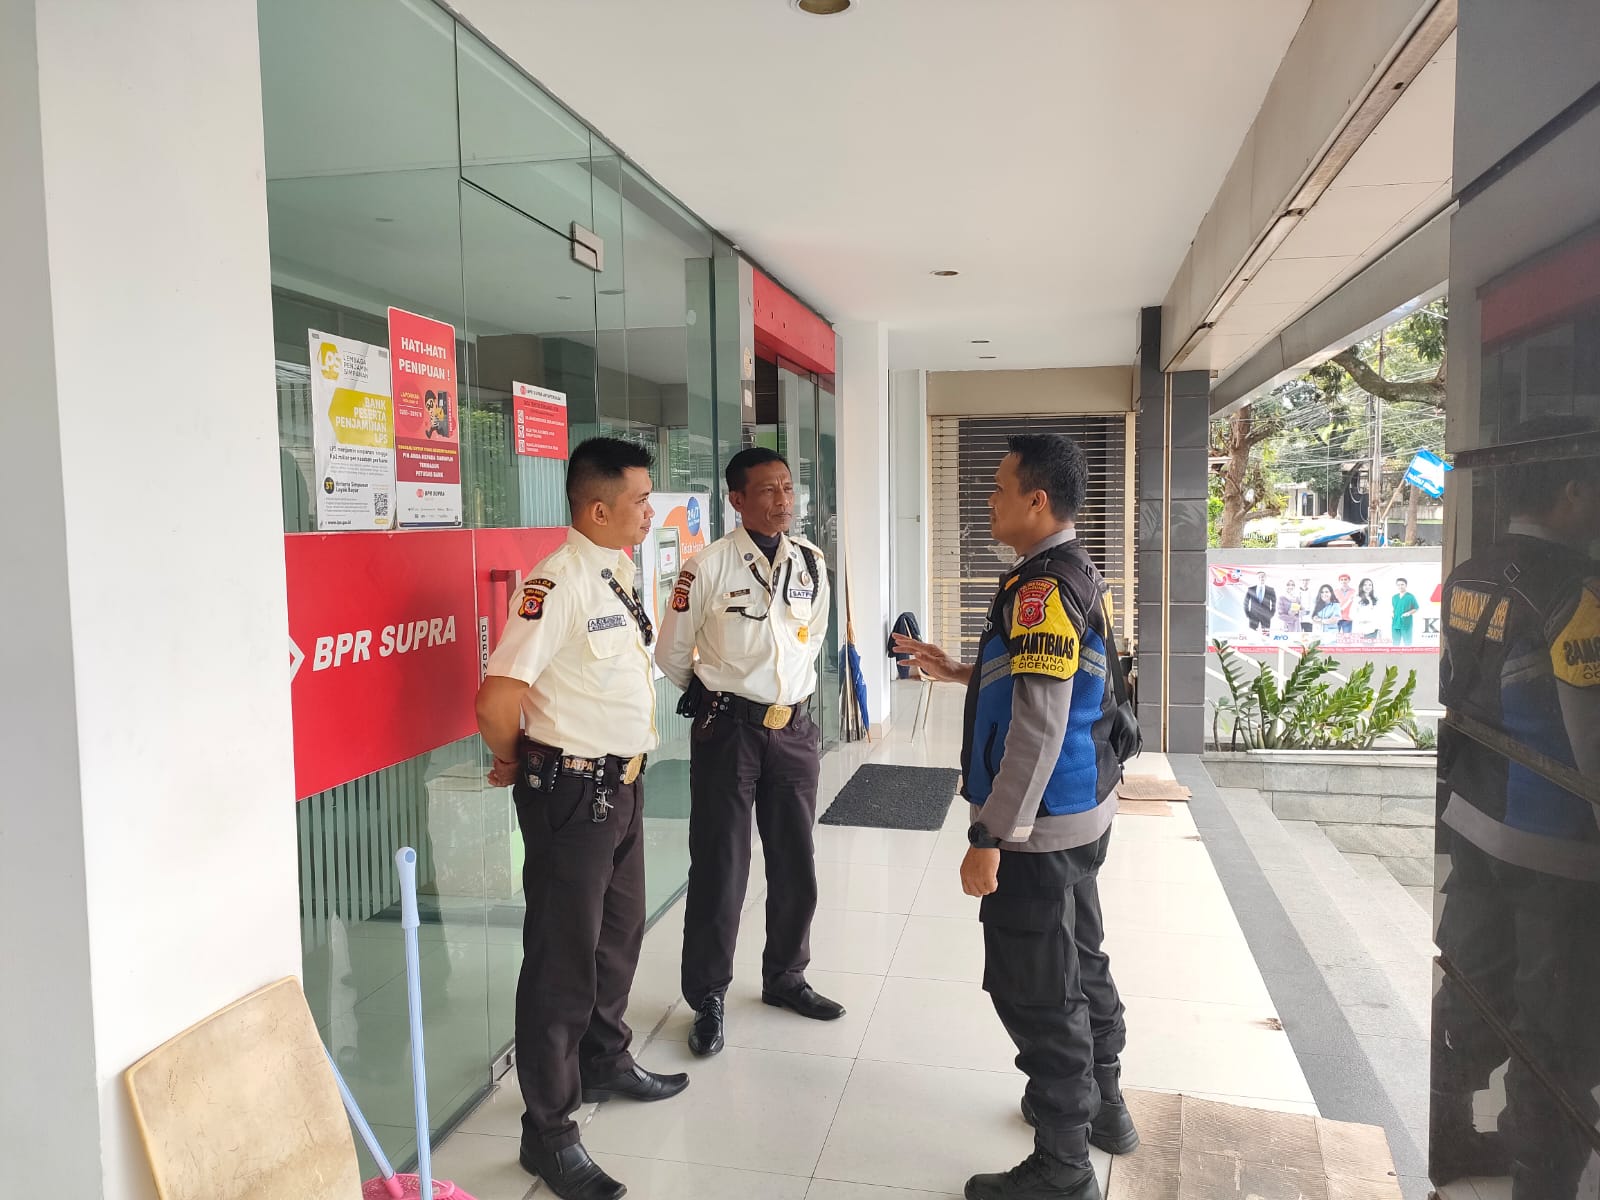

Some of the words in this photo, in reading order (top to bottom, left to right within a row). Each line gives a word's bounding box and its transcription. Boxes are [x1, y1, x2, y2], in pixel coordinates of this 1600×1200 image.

[401, 336, 446, 359] HATI-HATI
[398, 358, 445, 379] PENIPUAN
[364, 397, 386, 410] BANK
[354, 407, 387, 421] PESERTA
[335, 416, 387, 432] PENJAMINAN
[374, 432, 388, 444] LPS
[312, 630, 372, 672] BPR
[379, 615, 456, 658] SUPRA
[1018, 661, 1064, 672] CICENDO
[1020, 655, 1064, 665] ARJUNA
